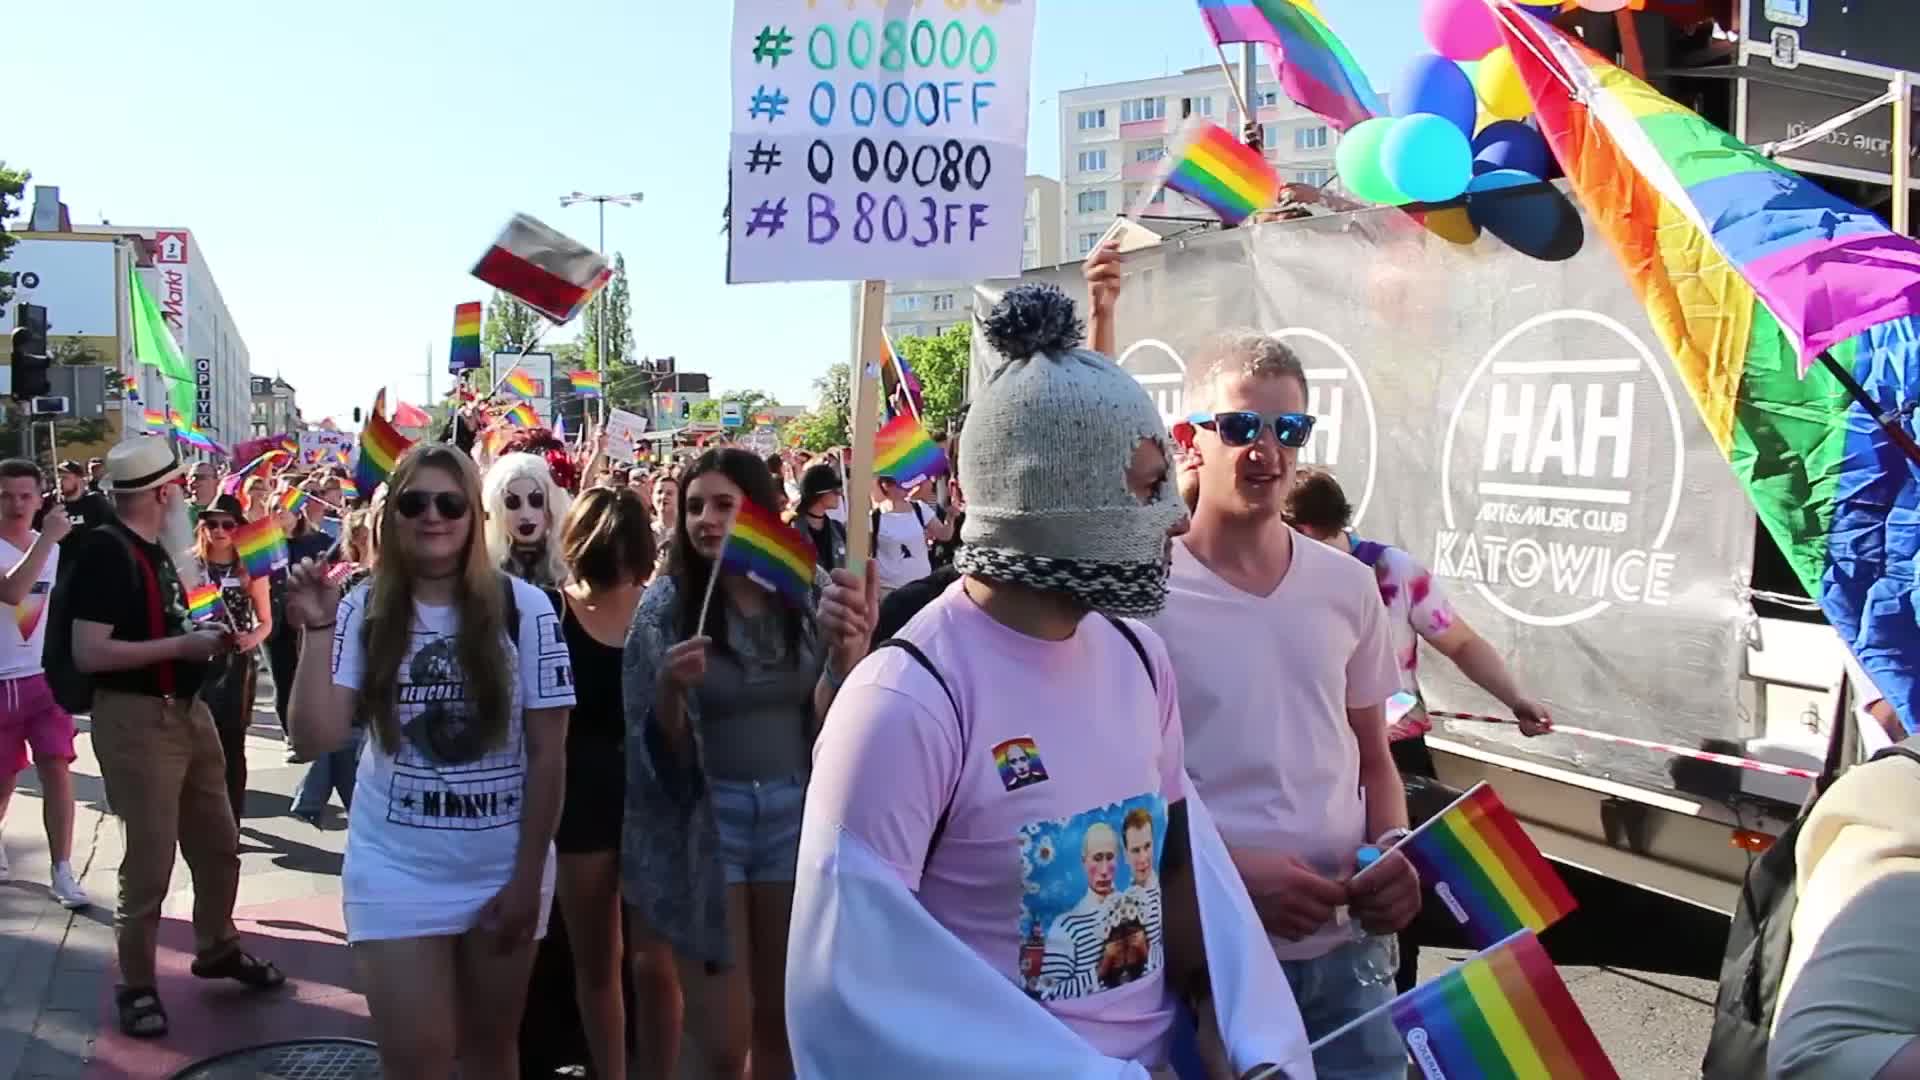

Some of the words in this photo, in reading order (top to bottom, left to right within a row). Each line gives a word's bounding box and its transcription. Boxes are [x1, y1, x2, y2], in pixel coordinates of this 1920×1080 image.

[752, 20, 998, 73] #008000
[748, 80, 997, 126] #0000FF
[744, 137, 991, 191] #000080
[198, 360, 210, 427] OPTYK
[1482, 382, 1635, 478] HAH
[1583, 510, 1628, 533] CLUB
[1433, 529, 1676, 606] KATOWICE
